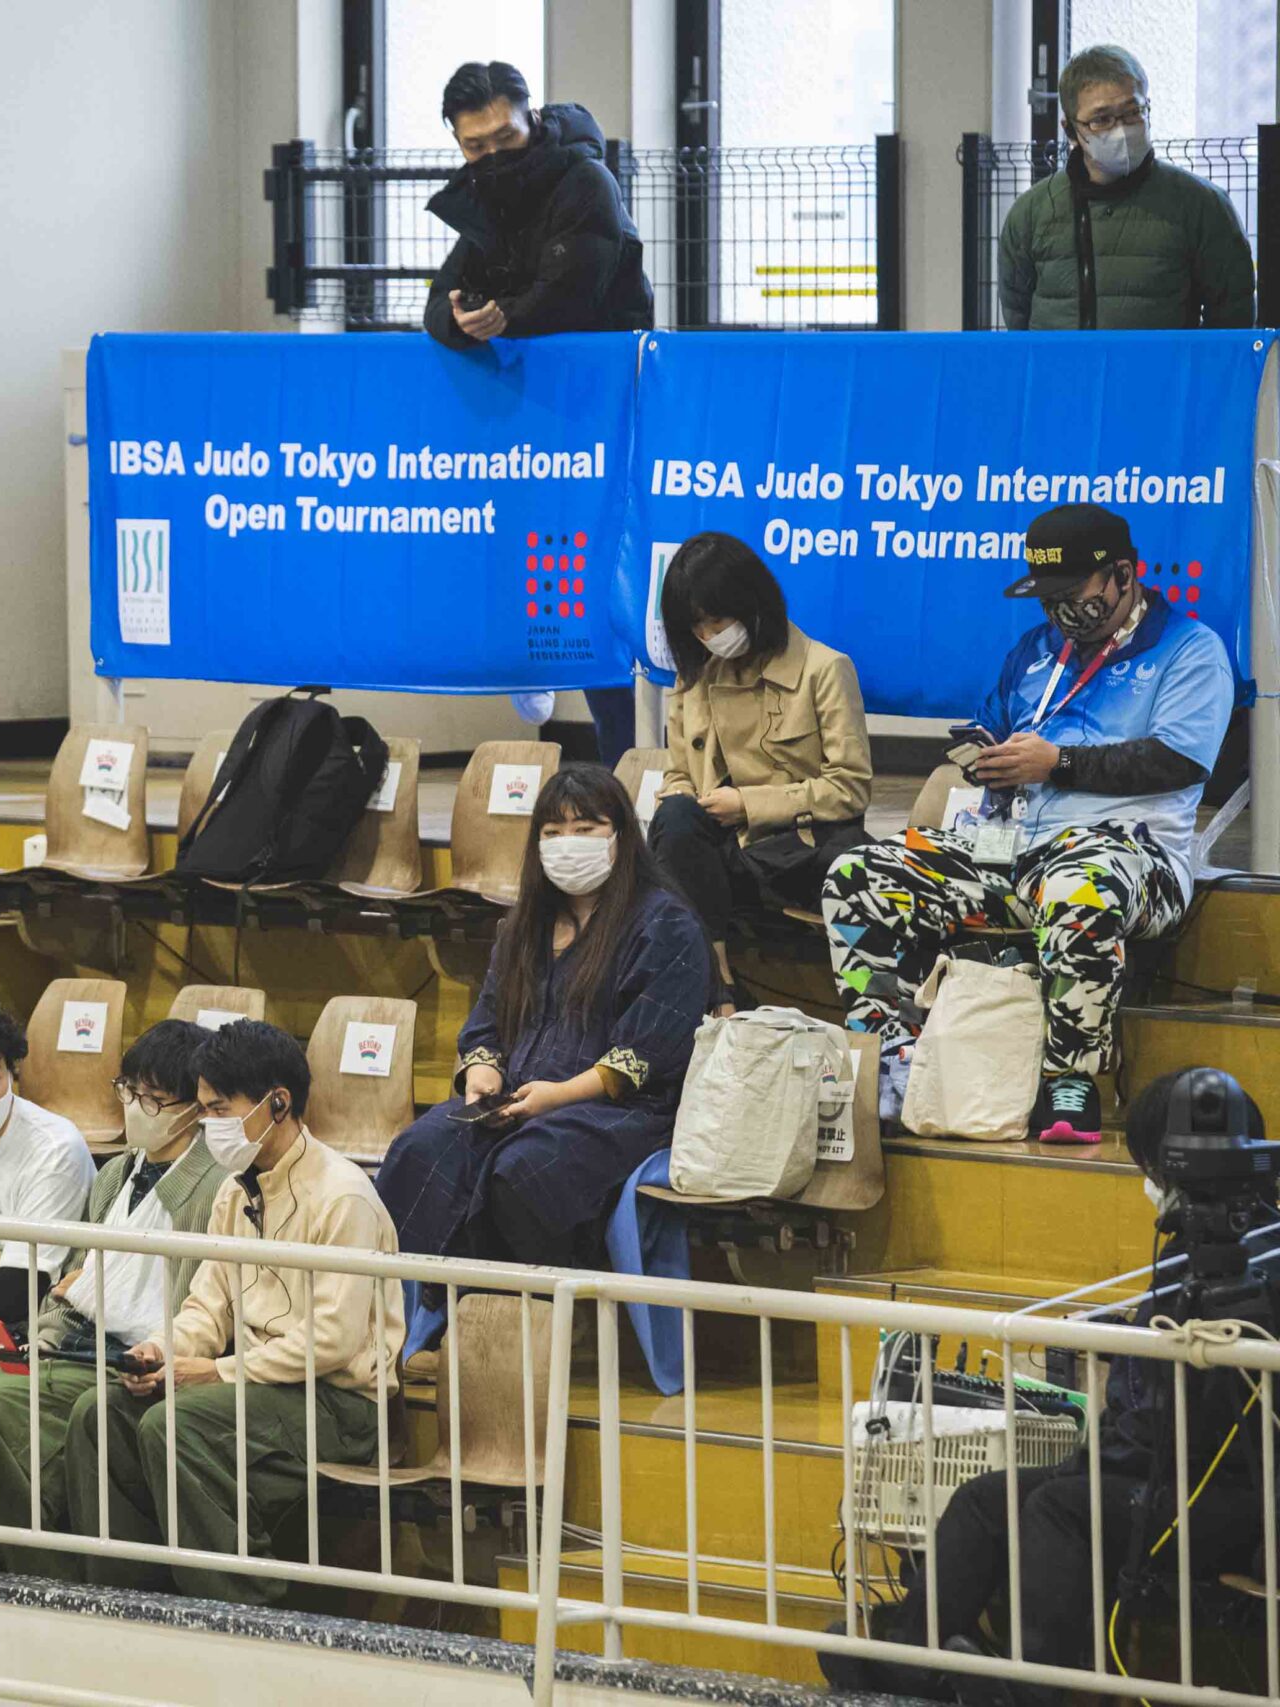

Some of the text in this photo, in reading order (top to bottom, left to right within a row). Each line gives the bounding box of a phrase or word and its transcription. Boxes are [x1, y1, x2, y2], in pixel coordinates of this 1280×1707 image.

[110, 440, 605, 488] IBSA Judo Tokyo International
[651, 459, 1225, 511] IBSA Judo Tokyo International
[205, 493, 496, 537] Open Tournament
[764, 518, 1027, 564] Open Tournam
